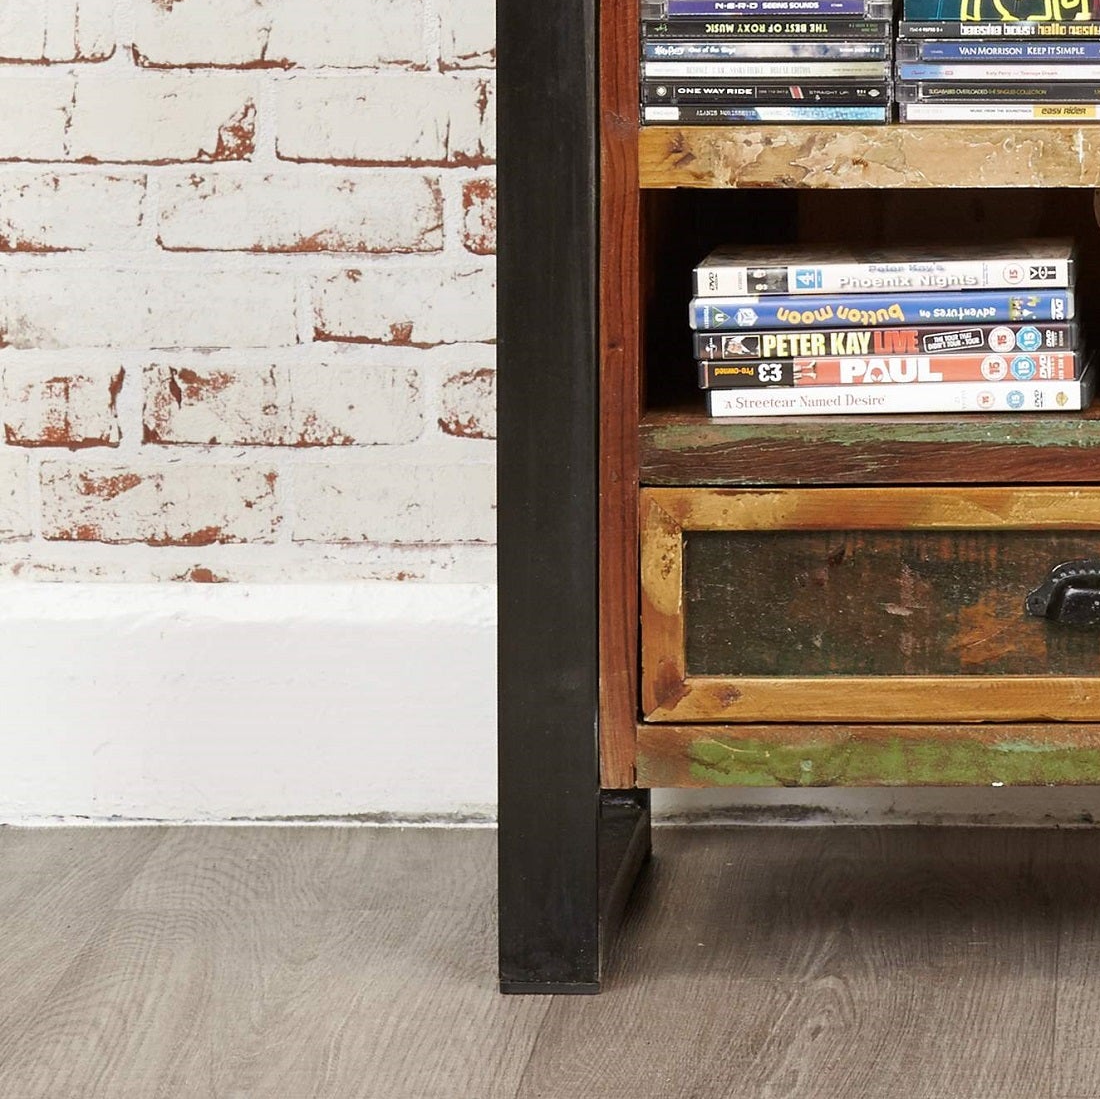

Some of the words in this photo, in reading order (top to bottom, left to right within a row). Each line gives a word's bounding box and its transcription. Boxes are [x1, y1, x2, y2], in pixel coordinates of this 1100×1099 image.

[762, 2, 788, 10] SEEING
[789, 2, 819, 10] SOUNDS
[705, 24, 734, 33] MUSIC
[737, 24, 765, 32] ROXY
[768, 24, 782, 32] OF
[785, 24, 807, 32] BEST
[810, 24, 828, 32] THE
[1027, 46, 1047, 54] KEEP
[1048, 46, 1055, 54] IT
[1056, 46, 1085, 54] SIMPLE
[1064, 106, 1086, 114] rider
[839, 275, 912, 288] Phoenix
[920, 274, 978, 288] Nights
[776, 305, 834, 324] moon
[837, 303, 906, 326] button
[919, 310, 931, 318] on
[933, 306, 996, 320] adventures
[762, 333, 826, 358] PETER
[830, 332, 872, 356] KAY
[873, 330, 920, 354] LIVE
[997, 334, 1007, 346] 15
[1024, 332, 1036, 346] 15
[714, 367, 754, 376] Pre-owned
[758, 364, 783, 382] £3
[839, 356, 944, 384] PAUL
[989, 362, 1000, 374] 15
[1018, 361, 1030, 375] 15
[1040, 355, 1048, 379] DVD
[736, 396, 796, 409] Streetcar
[800, 395, 841, 408] Named
[845, 394, 885, 406] Desire
